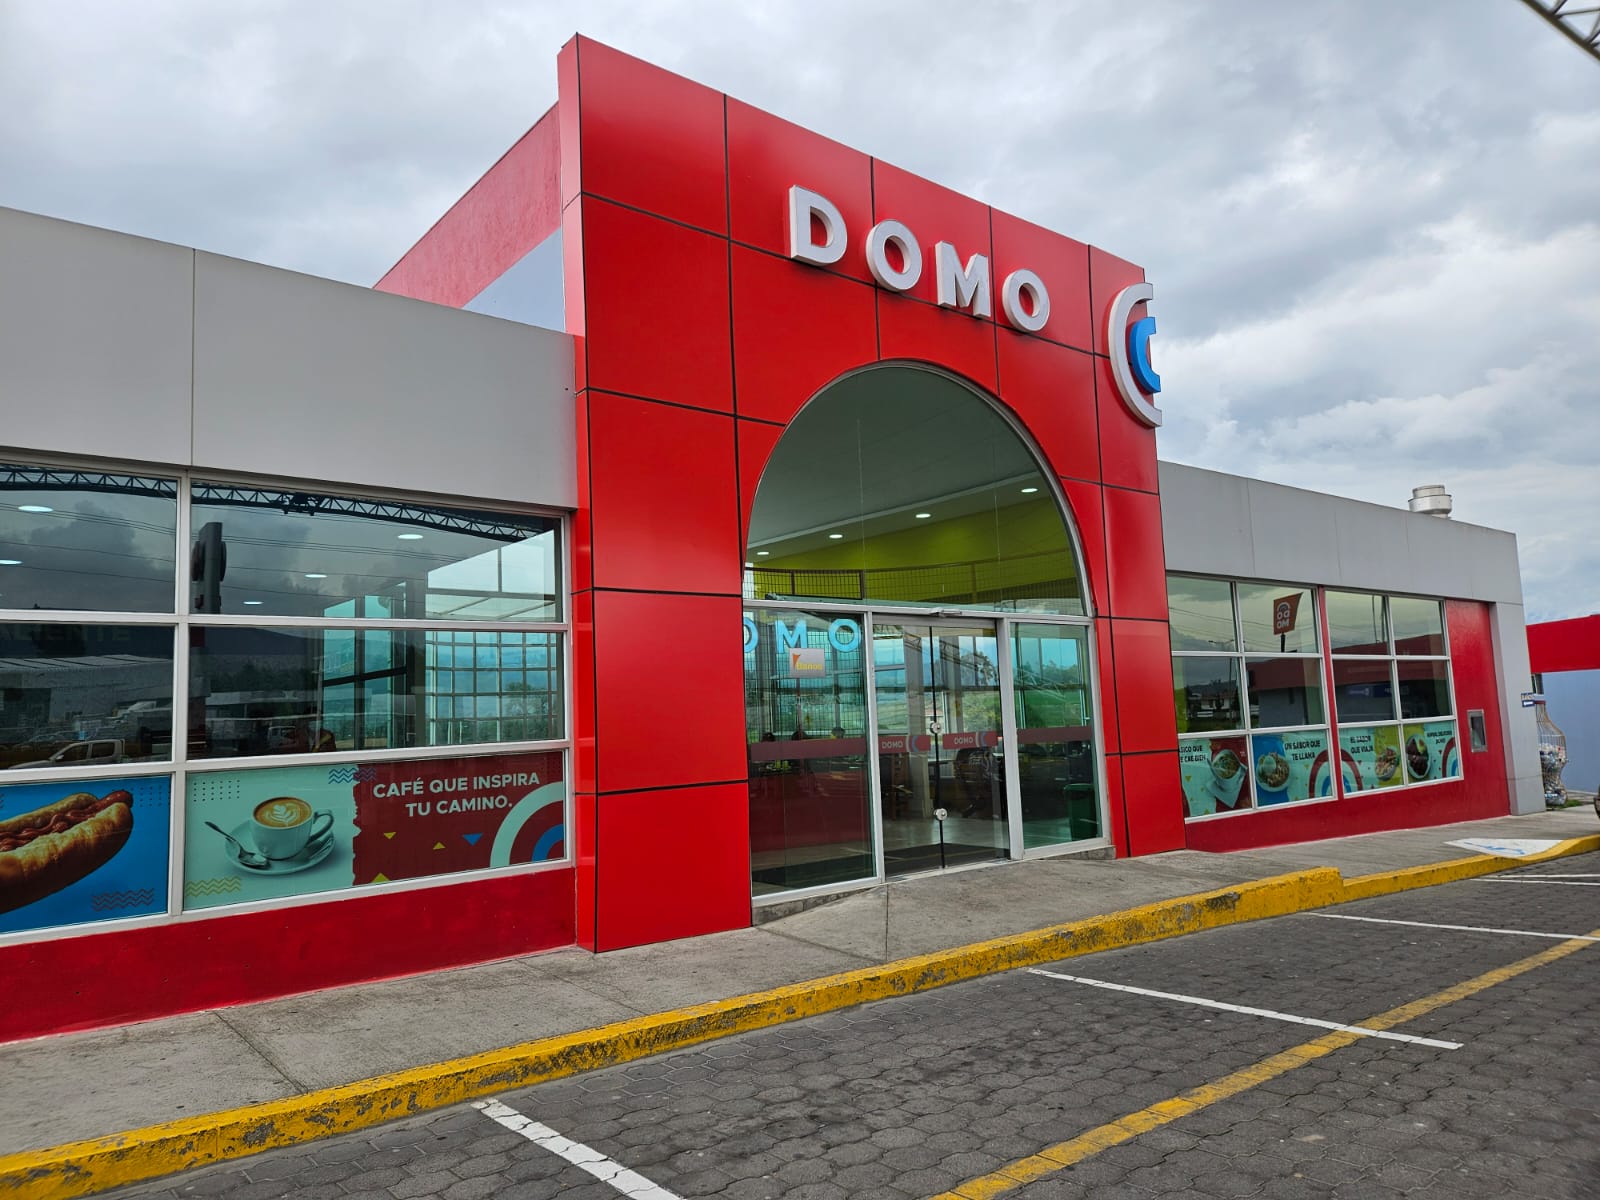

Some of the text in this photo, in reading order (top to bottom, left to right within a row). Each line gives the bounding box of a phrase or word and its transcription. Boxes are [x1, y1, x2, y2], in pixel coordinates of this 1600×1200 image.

[789, 184, 1051, 333] DOMO
[1310, 740, 1321, 748] QUE
[373, 772, 540, 798] CAFÉ QUE INSPIRA
[405, 795, 513, 817] TU CAMINO.
